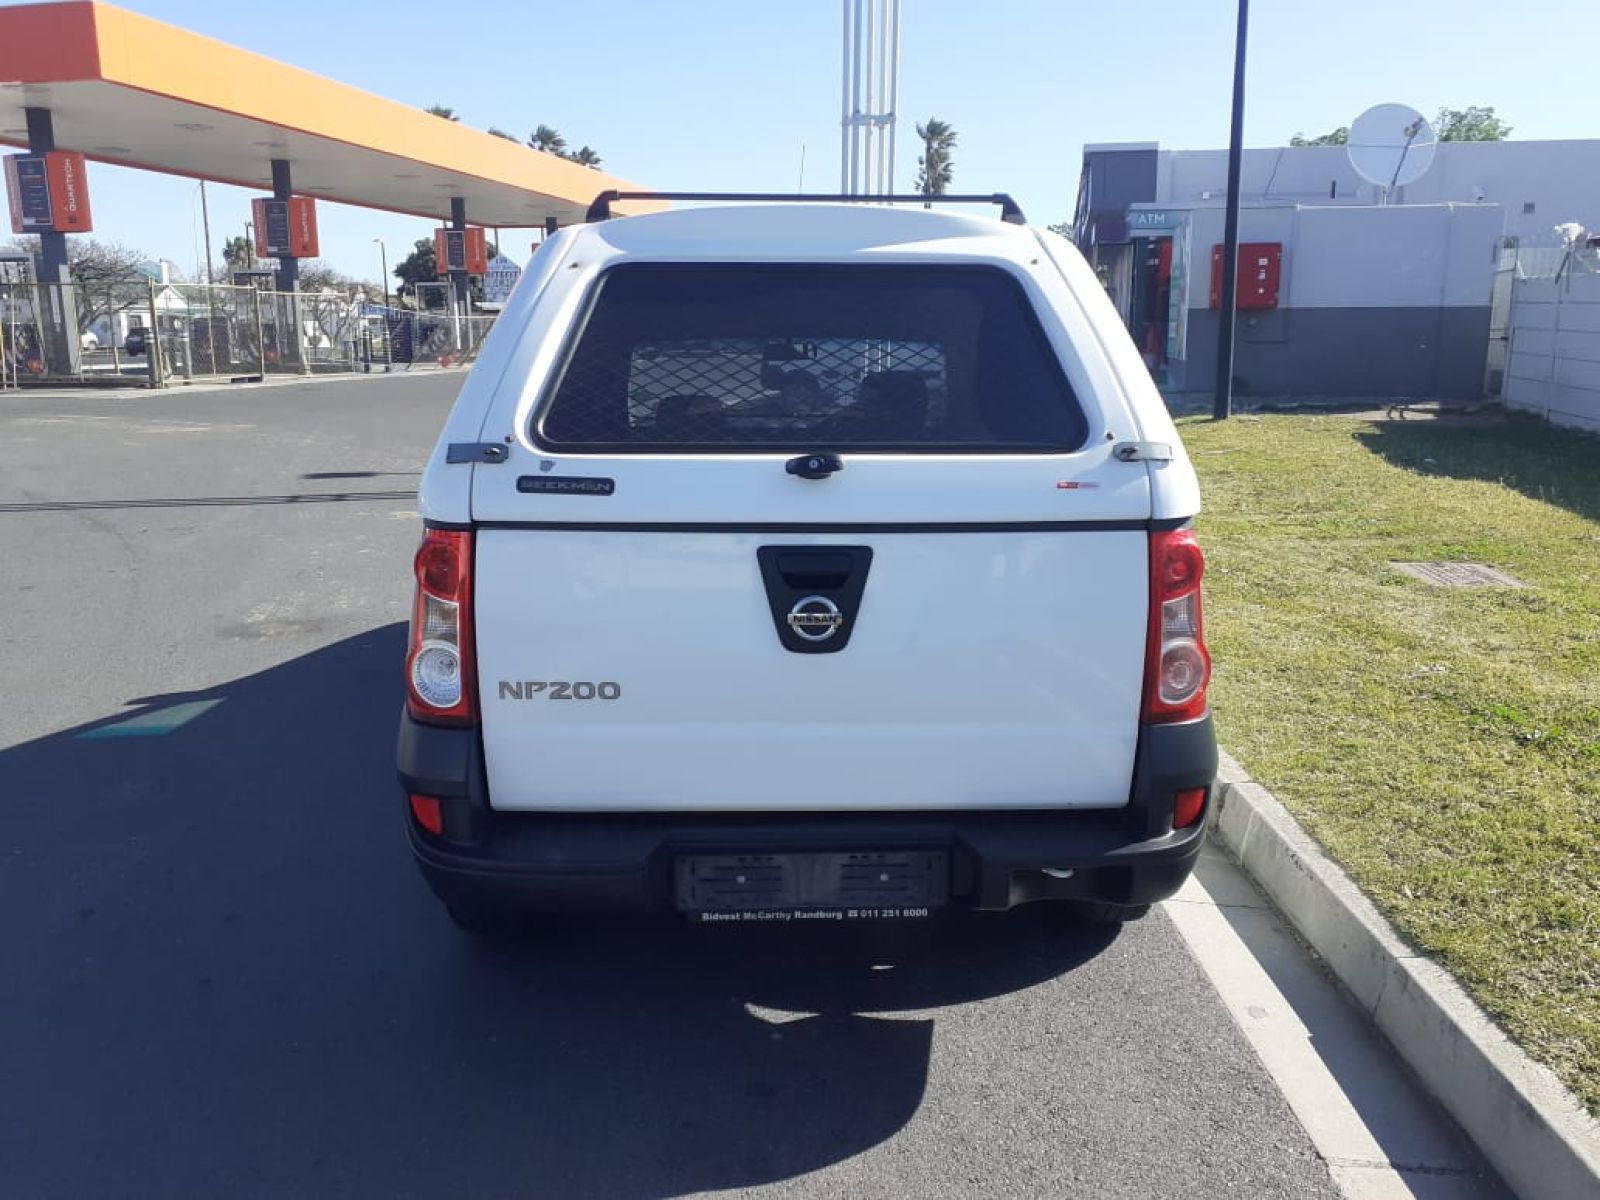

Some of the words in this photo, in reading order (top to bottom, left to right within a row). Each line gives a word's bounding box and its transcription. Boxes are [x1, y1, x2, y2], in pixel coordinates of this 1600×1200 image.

[1138, 213, 1165, 224] ATM
[793, 615, 837, 624] NISSAN
[498, 680, 621, 700] NP200
[701, 911, 740, 921] Bidvest
[743, 910, 791, 922] McCarthy
[795, 909, 843, 921] Randburg
[859, 909, 879, 918] 011
